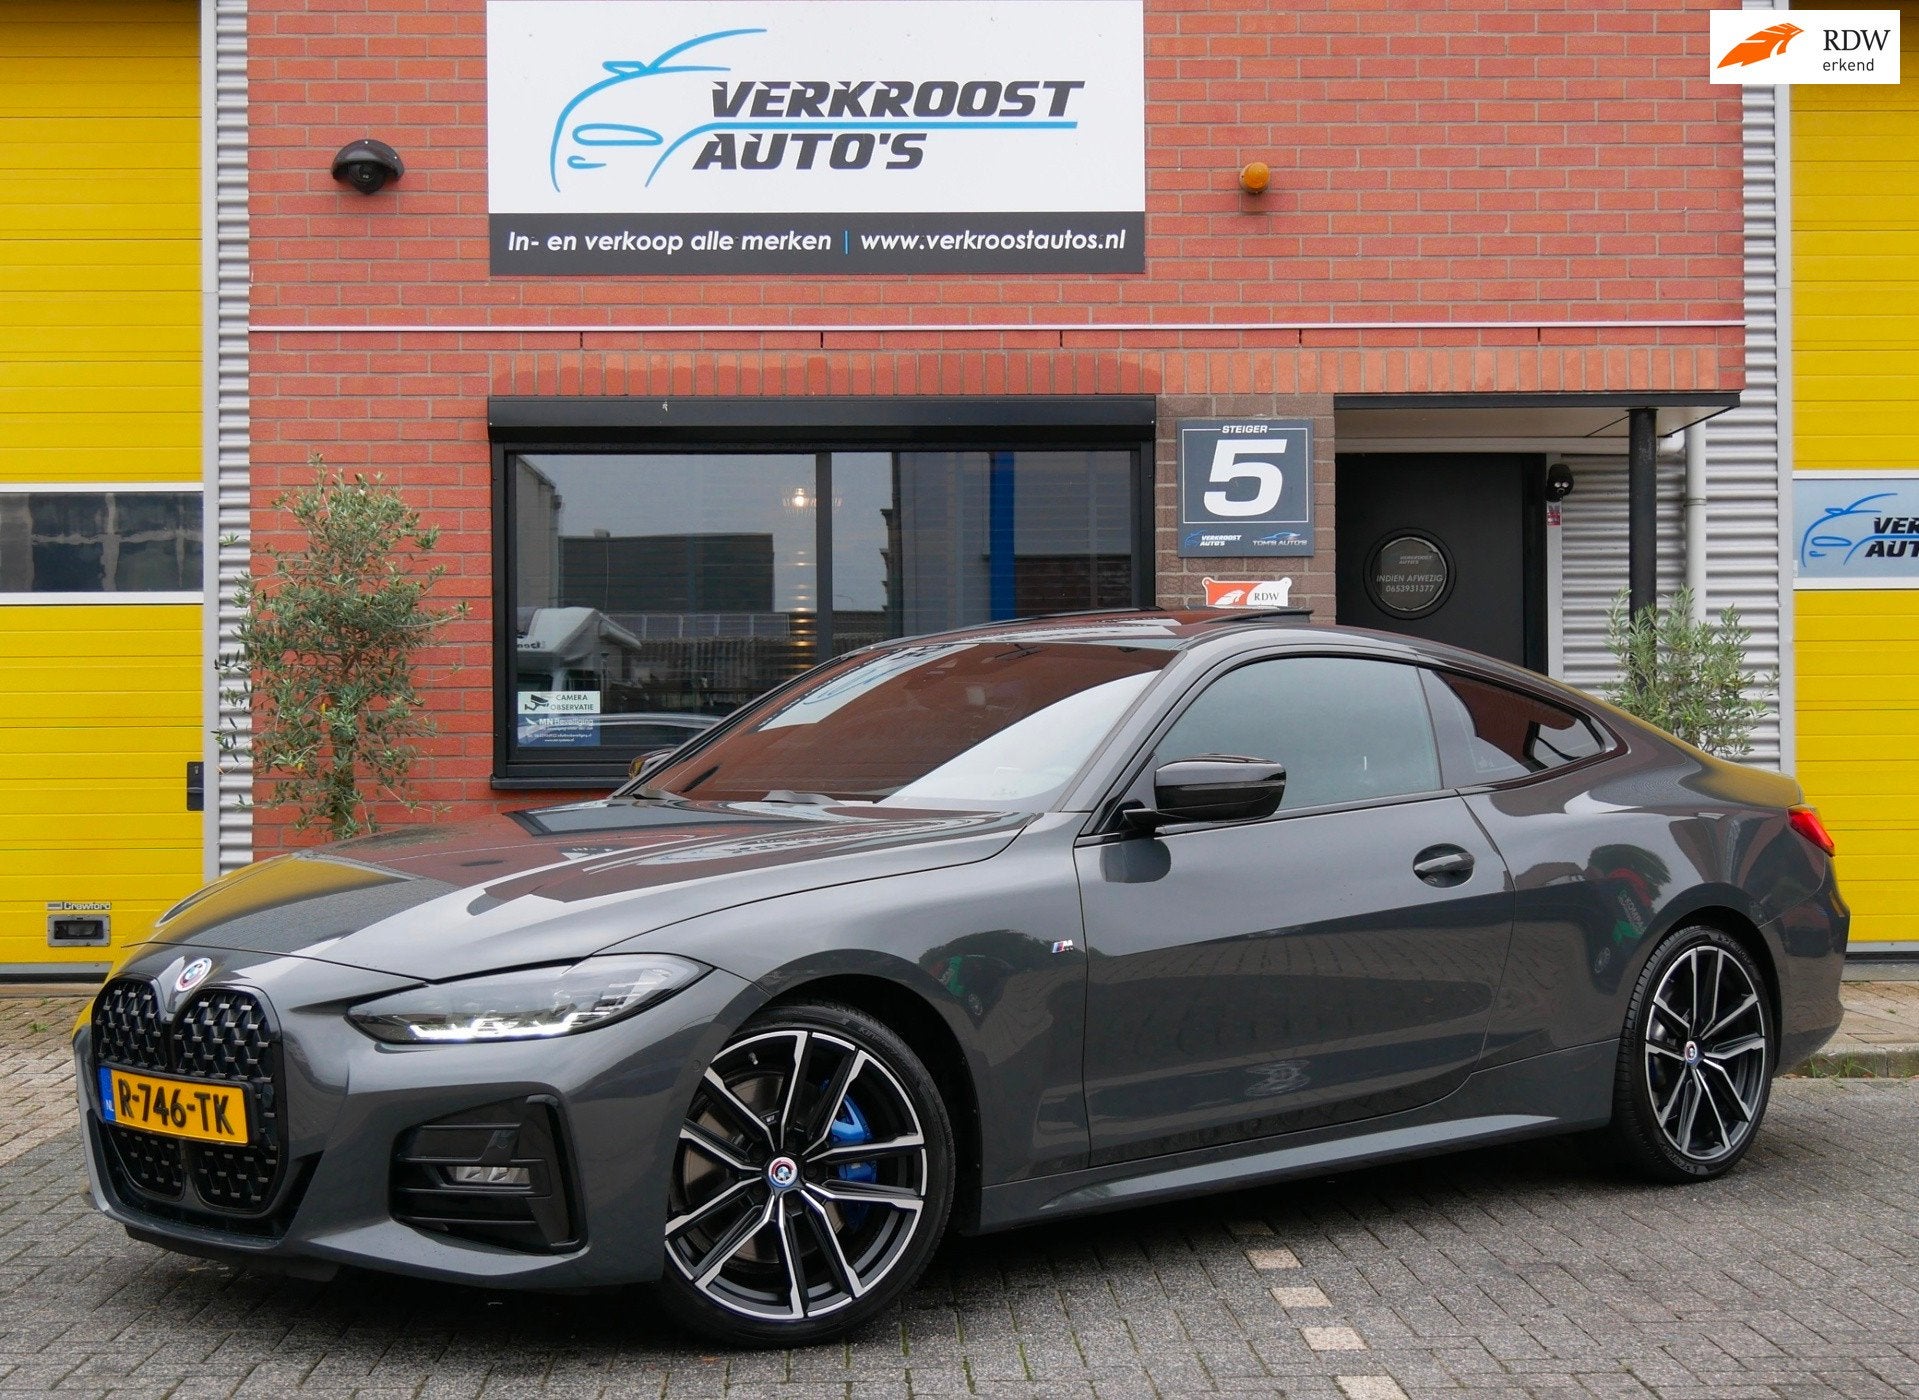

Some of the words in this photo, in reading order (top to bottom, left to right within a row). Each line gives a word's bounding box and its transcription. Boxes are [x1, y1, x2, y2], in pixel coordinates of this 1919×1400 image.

[711, 80, 1085, 118] VERKROOST
[692, 132, 927, 171] AUTO'S
[508, 231, 539, 251] In-
[547, 234, 577, 251] en
[585, 231, 684, 255] verkoop
[690, 231, 734, 251] alle
[741, 231, 831, 251] merken
[861, 229, 1126, 250] www.verkroostautos.nl
[1222, 425, 1268, 434] STEIGER
[1203, 439, 1288, 517] 5
[1376, 574, 1405, 583] INDIEN
[1406, 574, 1443, 582] AFWEZIG
[1253, 592, 1280, 601] RDW
[550, 703, 594, 711] OBSERVATIE
[117, 1078, 235, 1136] R-746-TK
